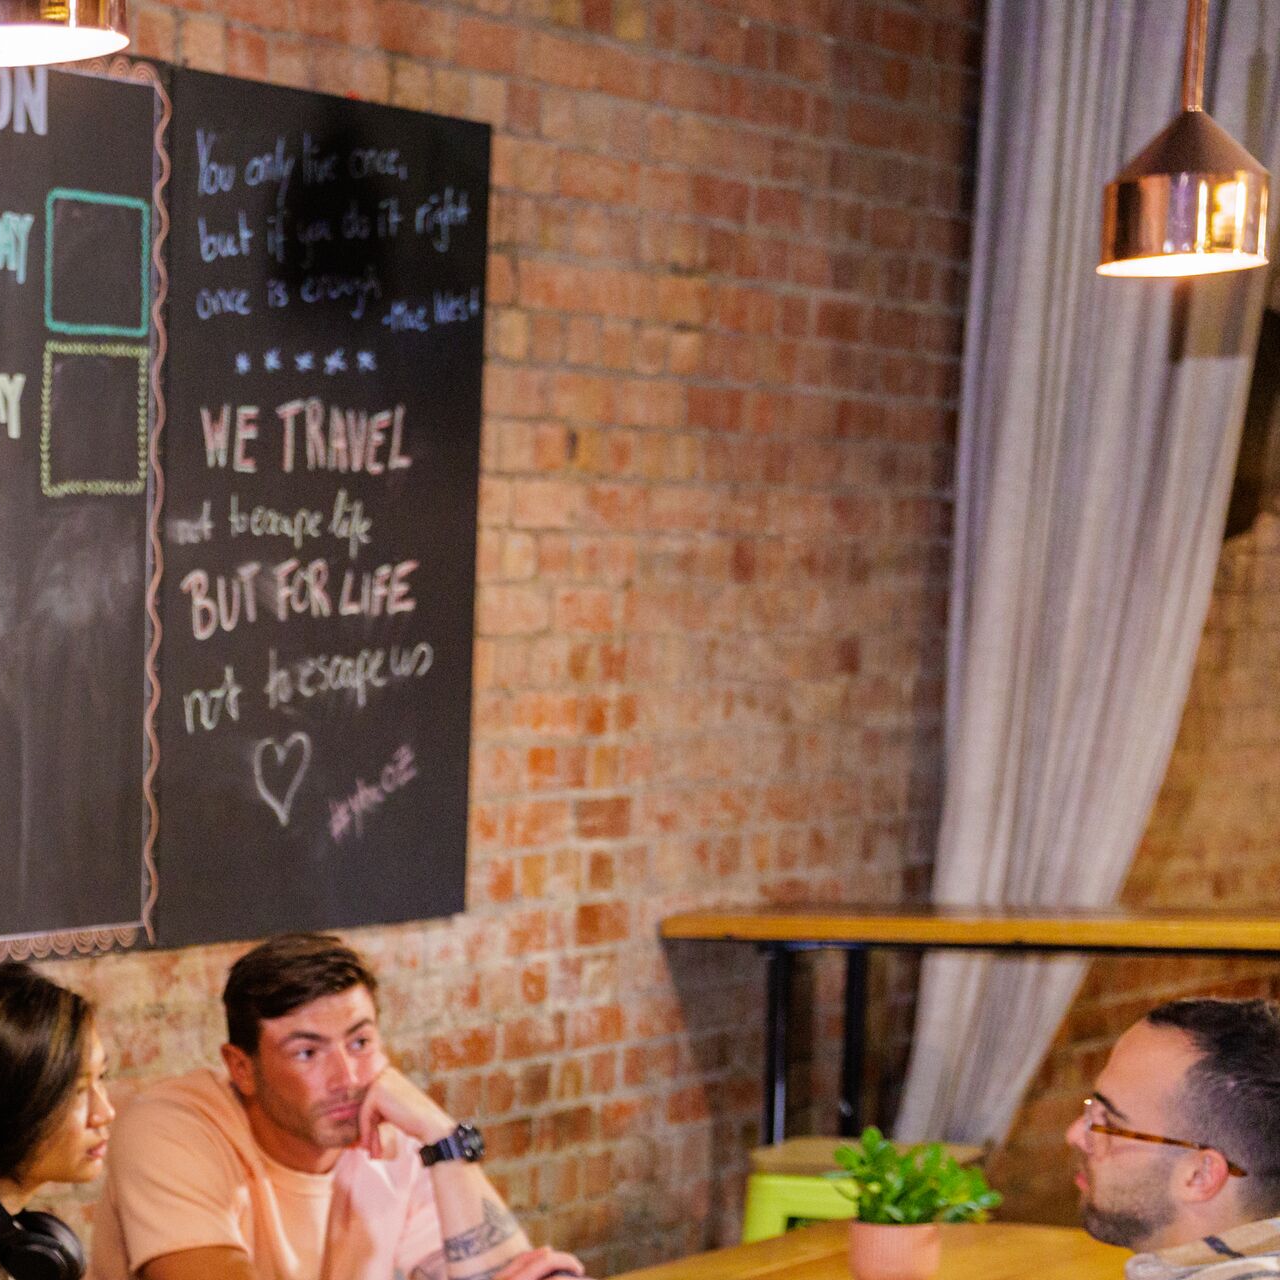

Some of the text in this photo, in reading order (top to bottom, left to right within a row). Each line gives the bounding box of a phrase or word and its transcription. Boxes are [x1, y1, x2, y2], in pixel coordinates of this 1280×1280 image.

[200, 397, 413, 475] WE TRAVEL
[180, 558, 419, 640] BUT FOR LIFE
